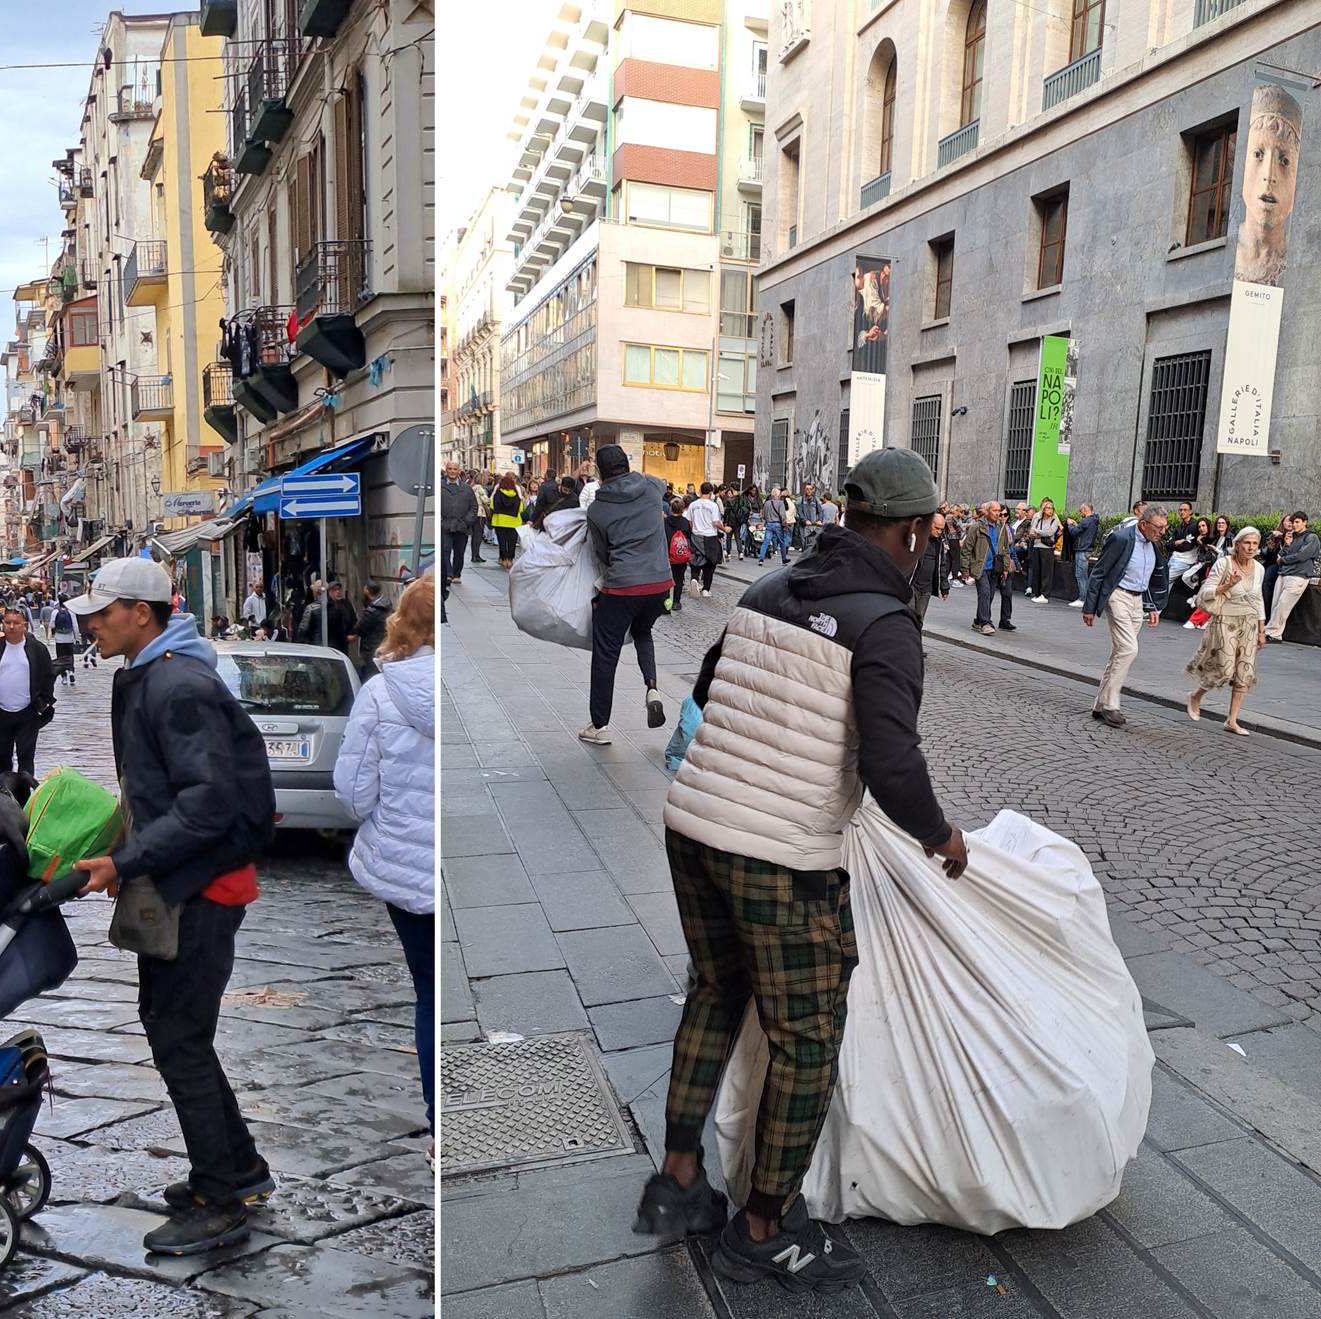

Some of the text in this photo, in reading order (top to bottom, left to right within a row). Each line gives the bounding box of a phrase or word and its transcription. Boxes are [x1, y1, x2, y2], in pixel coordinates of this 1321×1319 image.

[1244, 290, 1272, 301] GEMITO
[1042, 373, 1062, 390] NA
[1041, 389, 1061, 405] PO
[1039, 404, 1060, 421] LI?
[1229, 384, 1262, 437] GALLERIE D'ITALIA
[1227, 437, 1259, 447] NAPOLI
[808, 615, 831, 627] NORTH
[819, 612, 831, 621] THE
[810, 622, 829, 634] FACE
[771, 1244, 816, 1273] N
